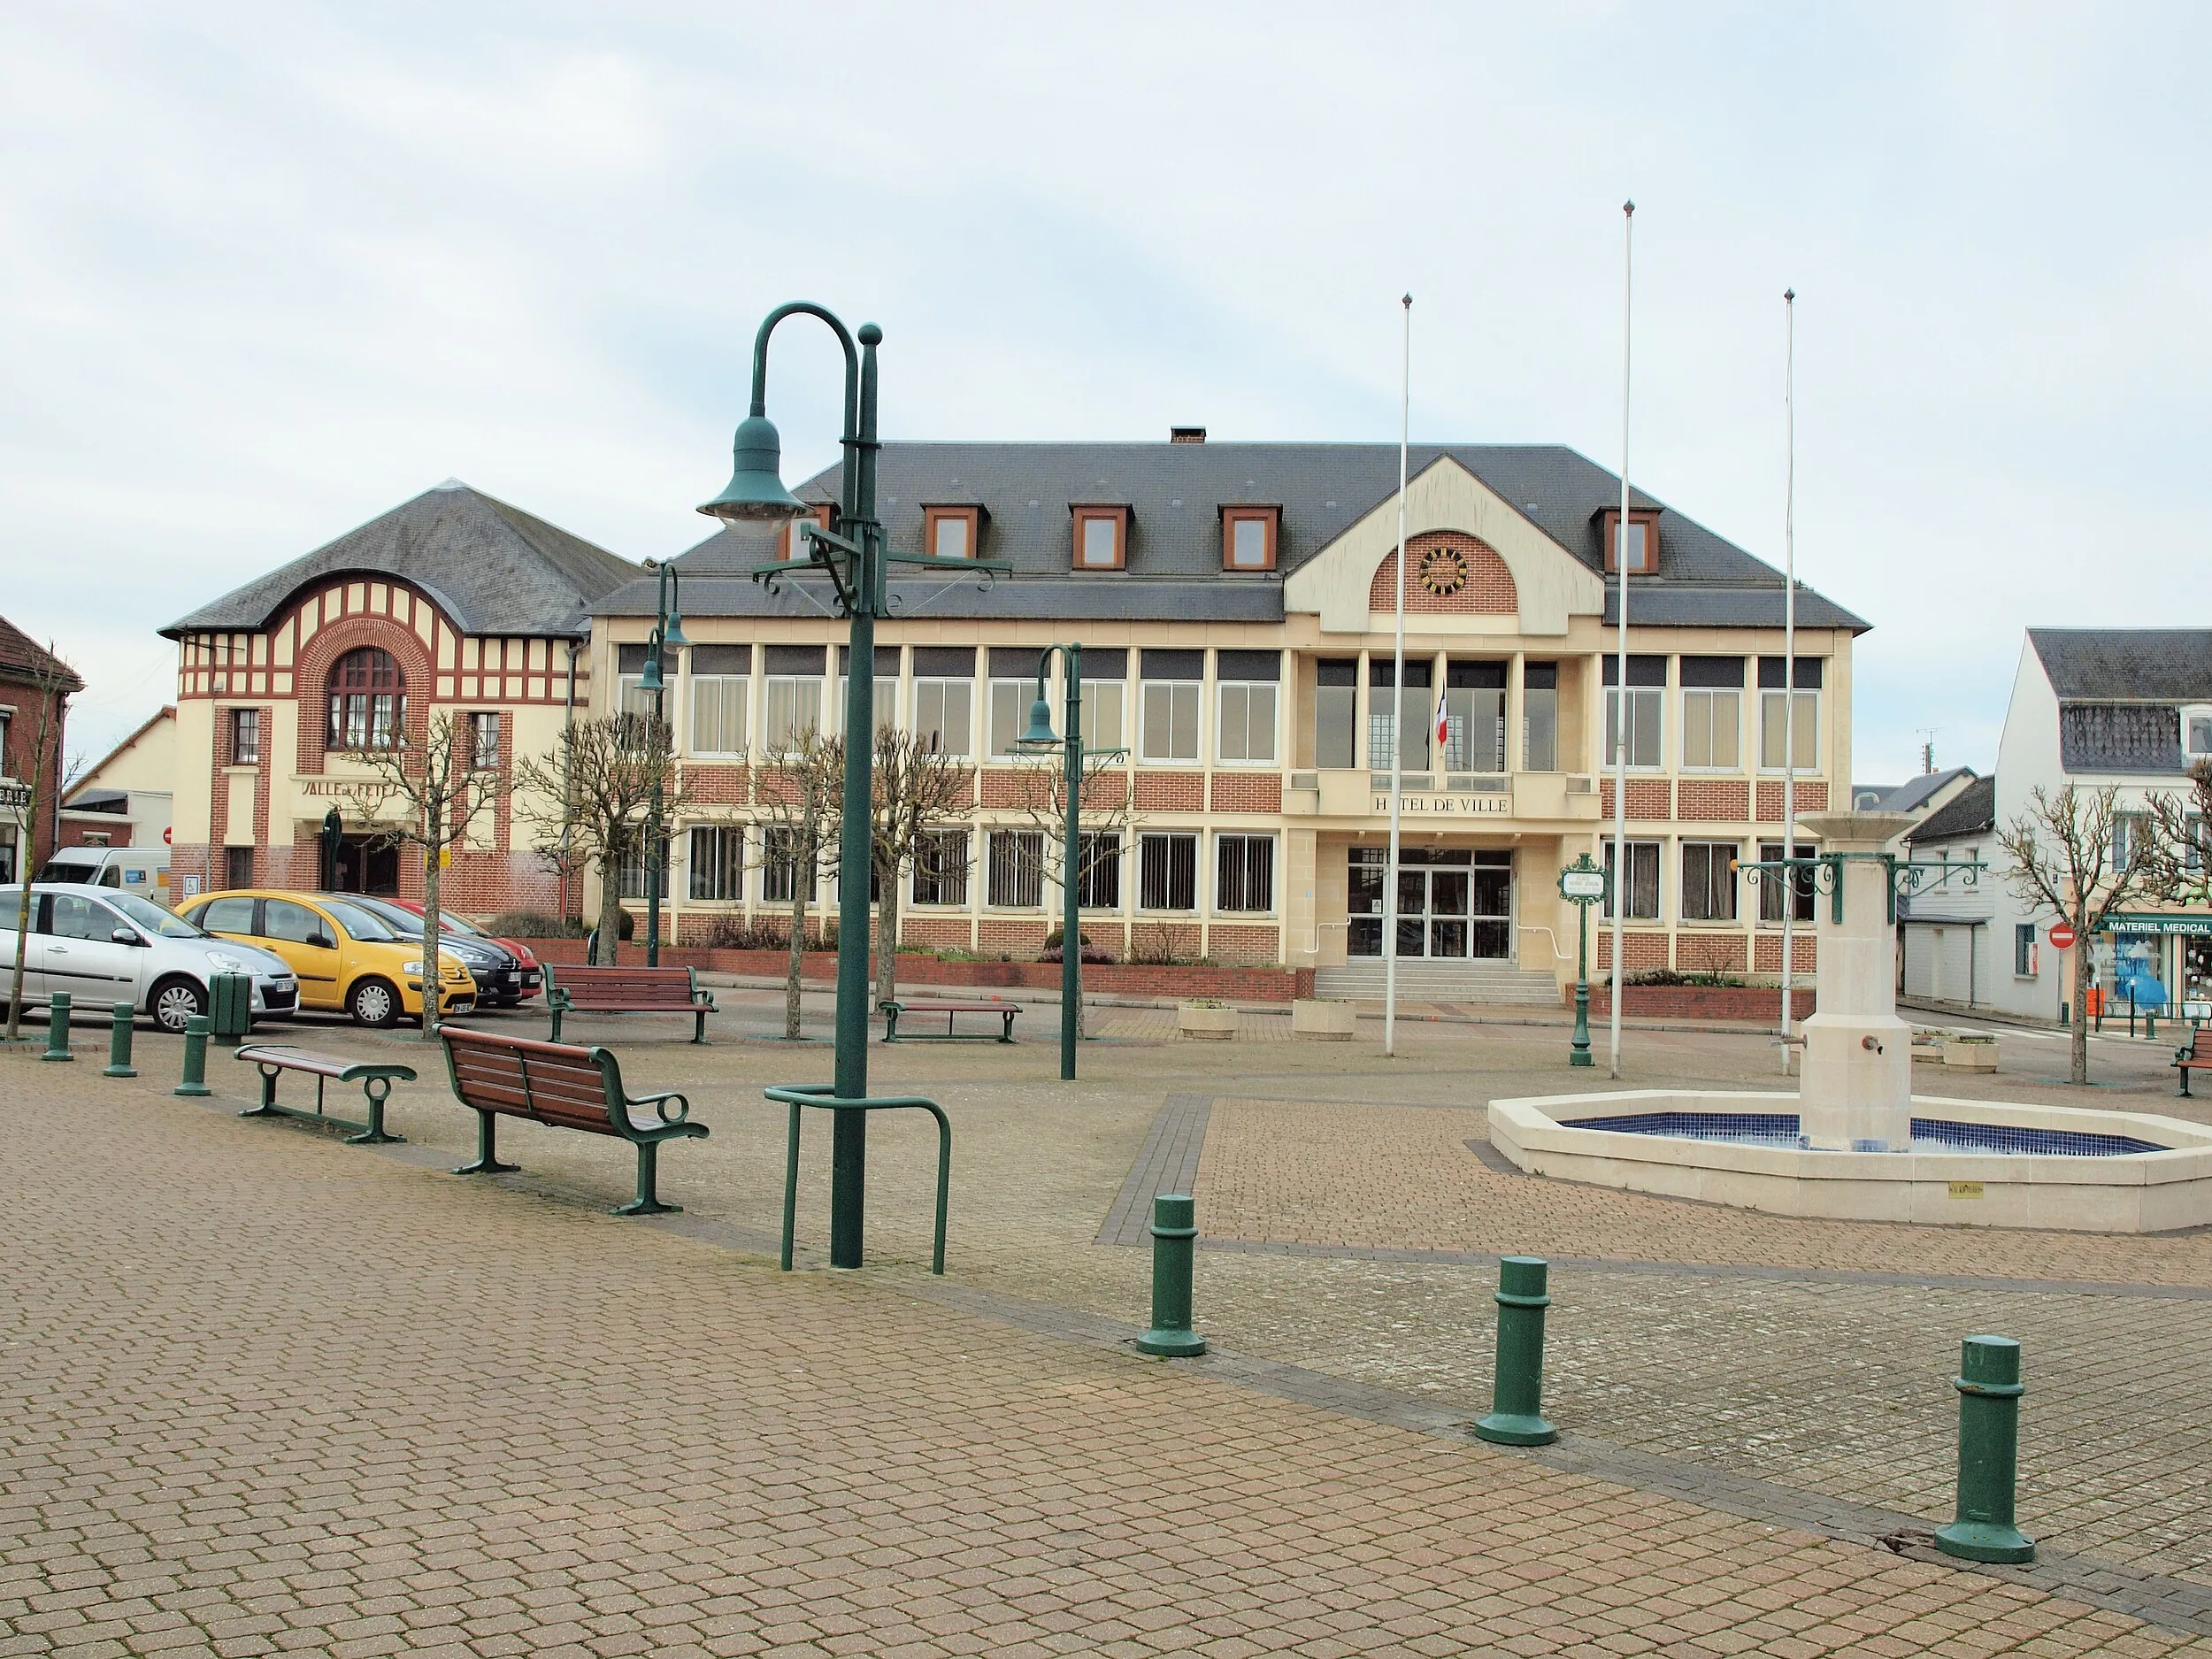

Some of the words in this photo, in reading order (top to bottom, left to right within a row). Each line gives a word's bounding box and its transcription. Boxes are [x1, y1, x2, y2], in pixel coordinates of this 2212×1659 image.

[302, 782, 342, 795] SALLE
[1375, 797, 1429, 810] HTEL
[1433, 798, 1455, 811] DE
[1460, 799, 1508, 812] VILLE
[2108, 922, 2161, 932] MATERIEL
[2163, 923, 2210, 933] MEDICAL
